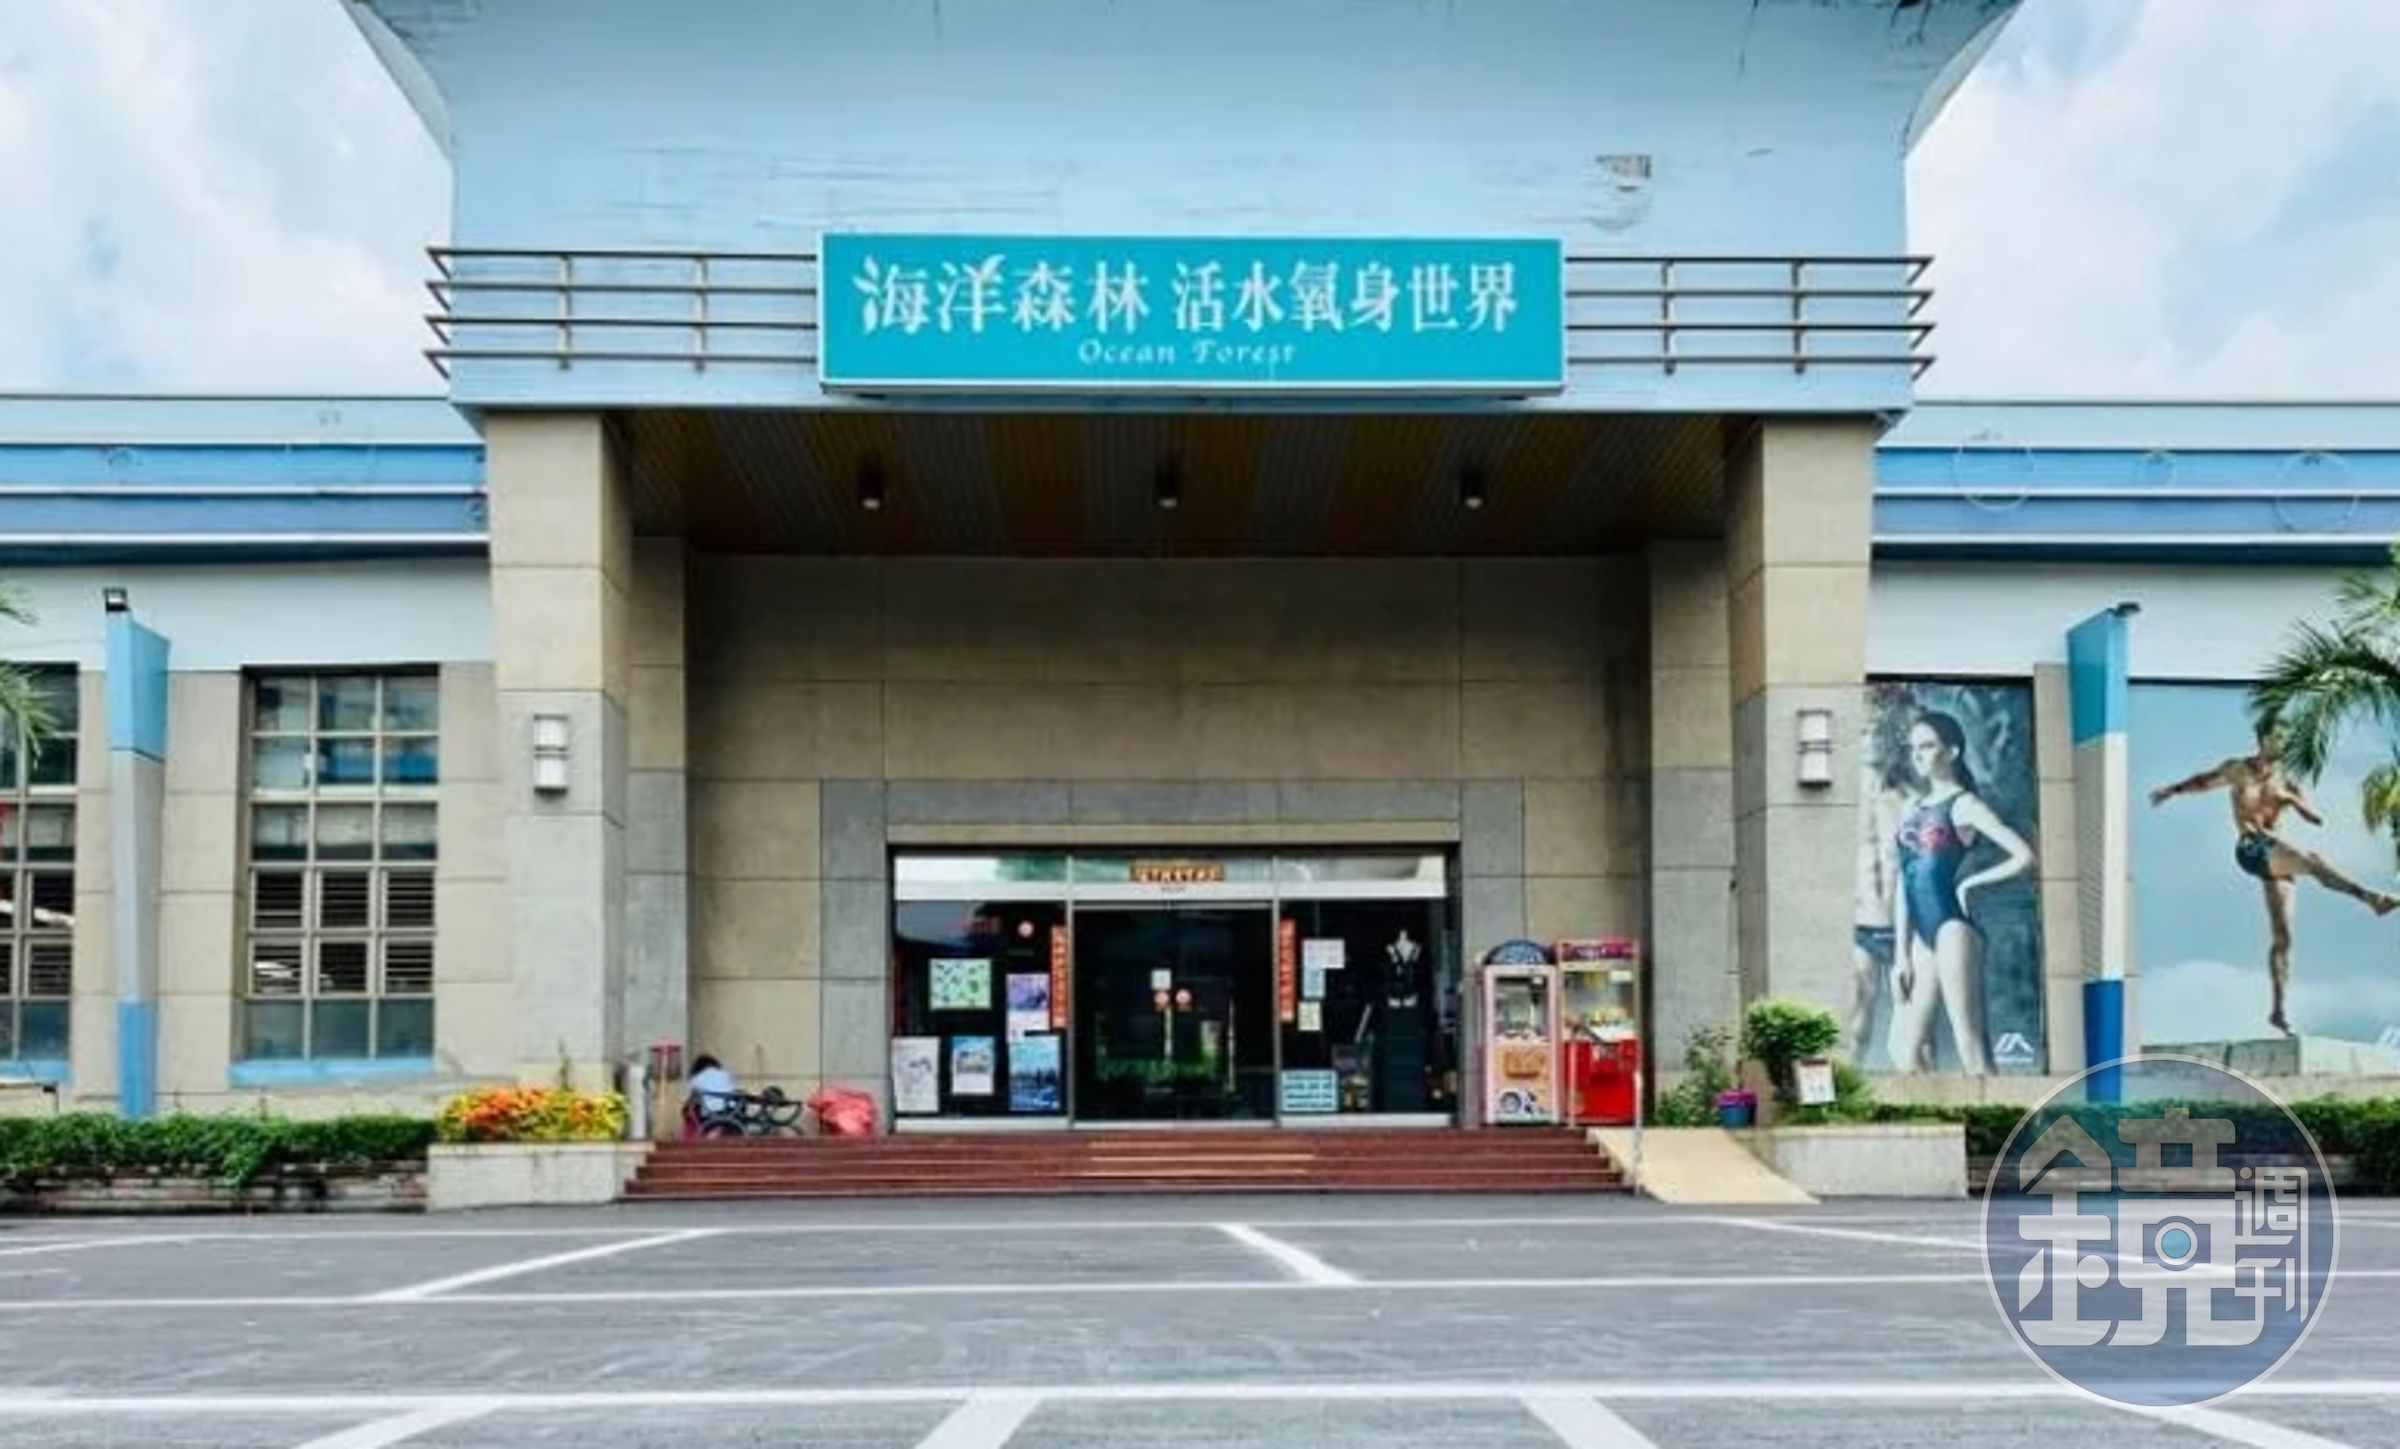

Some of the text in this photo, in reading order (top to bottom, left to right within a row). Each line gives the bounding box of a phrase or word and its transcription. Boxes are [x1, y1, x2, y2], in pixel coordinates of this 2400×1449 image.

[853, 254, 1517, 335] 海洋森林 活水氧身世界
[1078, 338, 1297, 365] Ocean Forest
